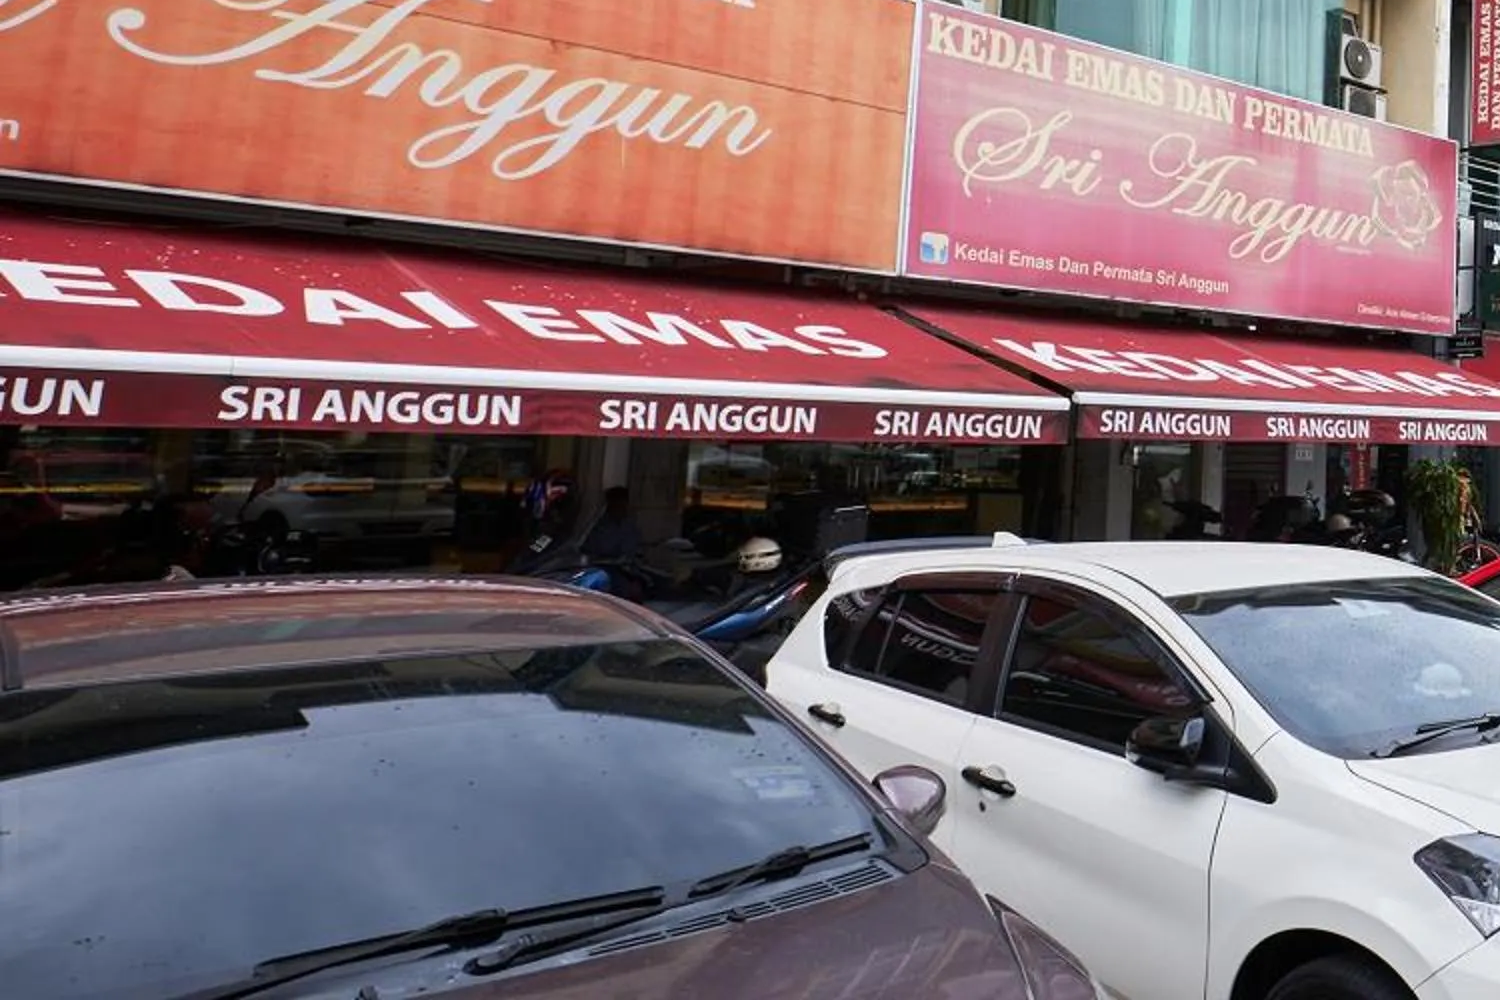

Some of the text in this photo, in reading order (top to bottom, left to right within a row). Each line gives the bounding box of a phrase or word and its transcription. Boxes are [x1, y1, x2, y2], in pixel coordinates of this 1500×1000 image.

[926, 12, 1374, 158] KEDAI EMAS DAN PERMATA
[1478, 2, 1492, 123] KEDAI EMAS
[953, 106, 1379, 263] Sri Anggun
[954, 242, 1230, 294] Kedai Emas Dan Permata Sri Anggun
[0, 259, 889, 359] EDAI EMAS
[992, 338, 1317, 389] KEDAI
[217, 385, 521, 427] SRI ANGGUN
[599, 399, 817, 435] SRI ANGGUN
[873, 410, 1042, 440] SRI ANGGUN
[1100, 409, 1231, 437] SRI ANGGUN
[1266, 417, 1370, 439] SRI ANGGUN
[1399, 421, 1487, 442] SRI ANGGUN
